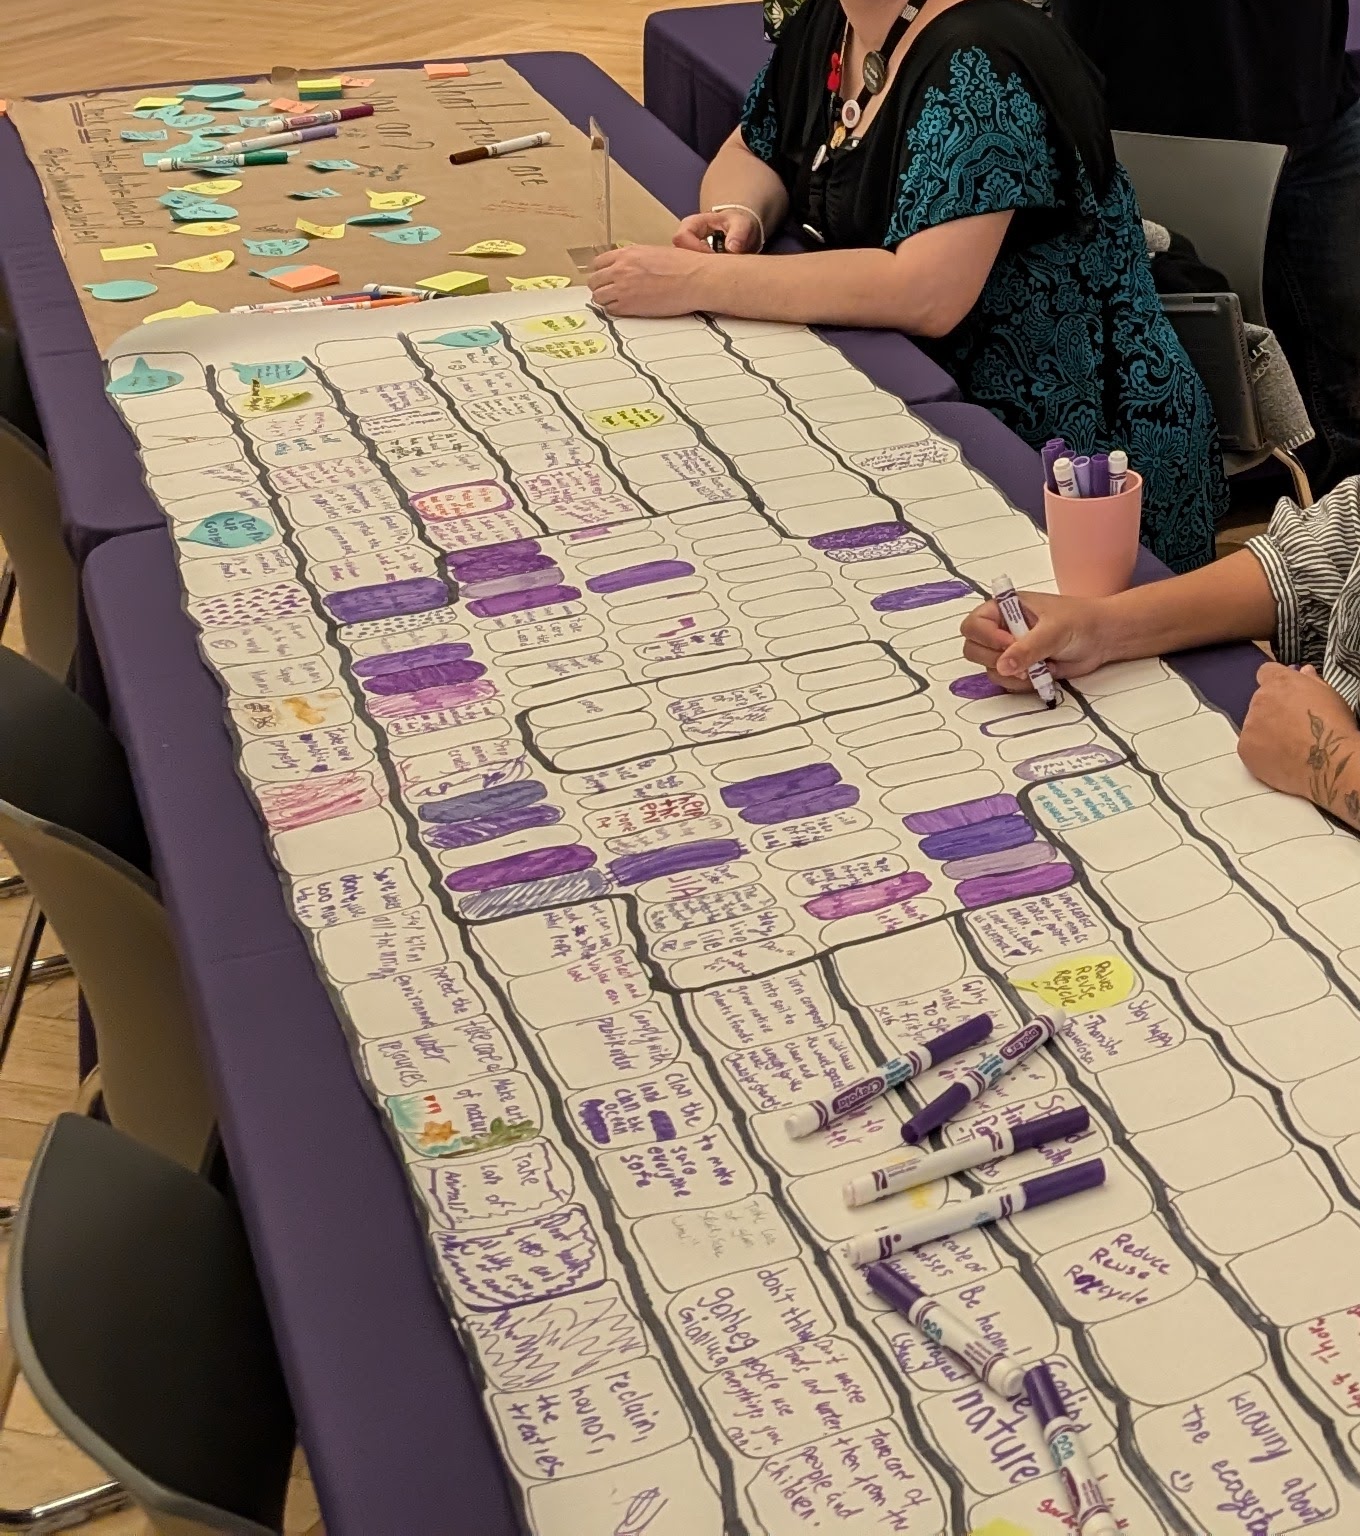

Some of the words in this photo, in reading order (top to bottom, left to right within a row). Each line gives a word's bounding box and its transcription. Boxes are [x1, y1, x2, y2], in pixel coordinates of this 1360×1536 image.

[1089, 1247, 1150, 1279] Reuse
[1111, 1233, 1170, 1275] Reduce
[757, 1268, 797, 1304] don't
[959, 1284, 985, 1309] Be
[537, 1395, 560, 1424] the
[605, 1371, 659, 1443] reclaim,
[507, 1404, 564, 1477] treaties
[786, 1446, 833, 1494] people
